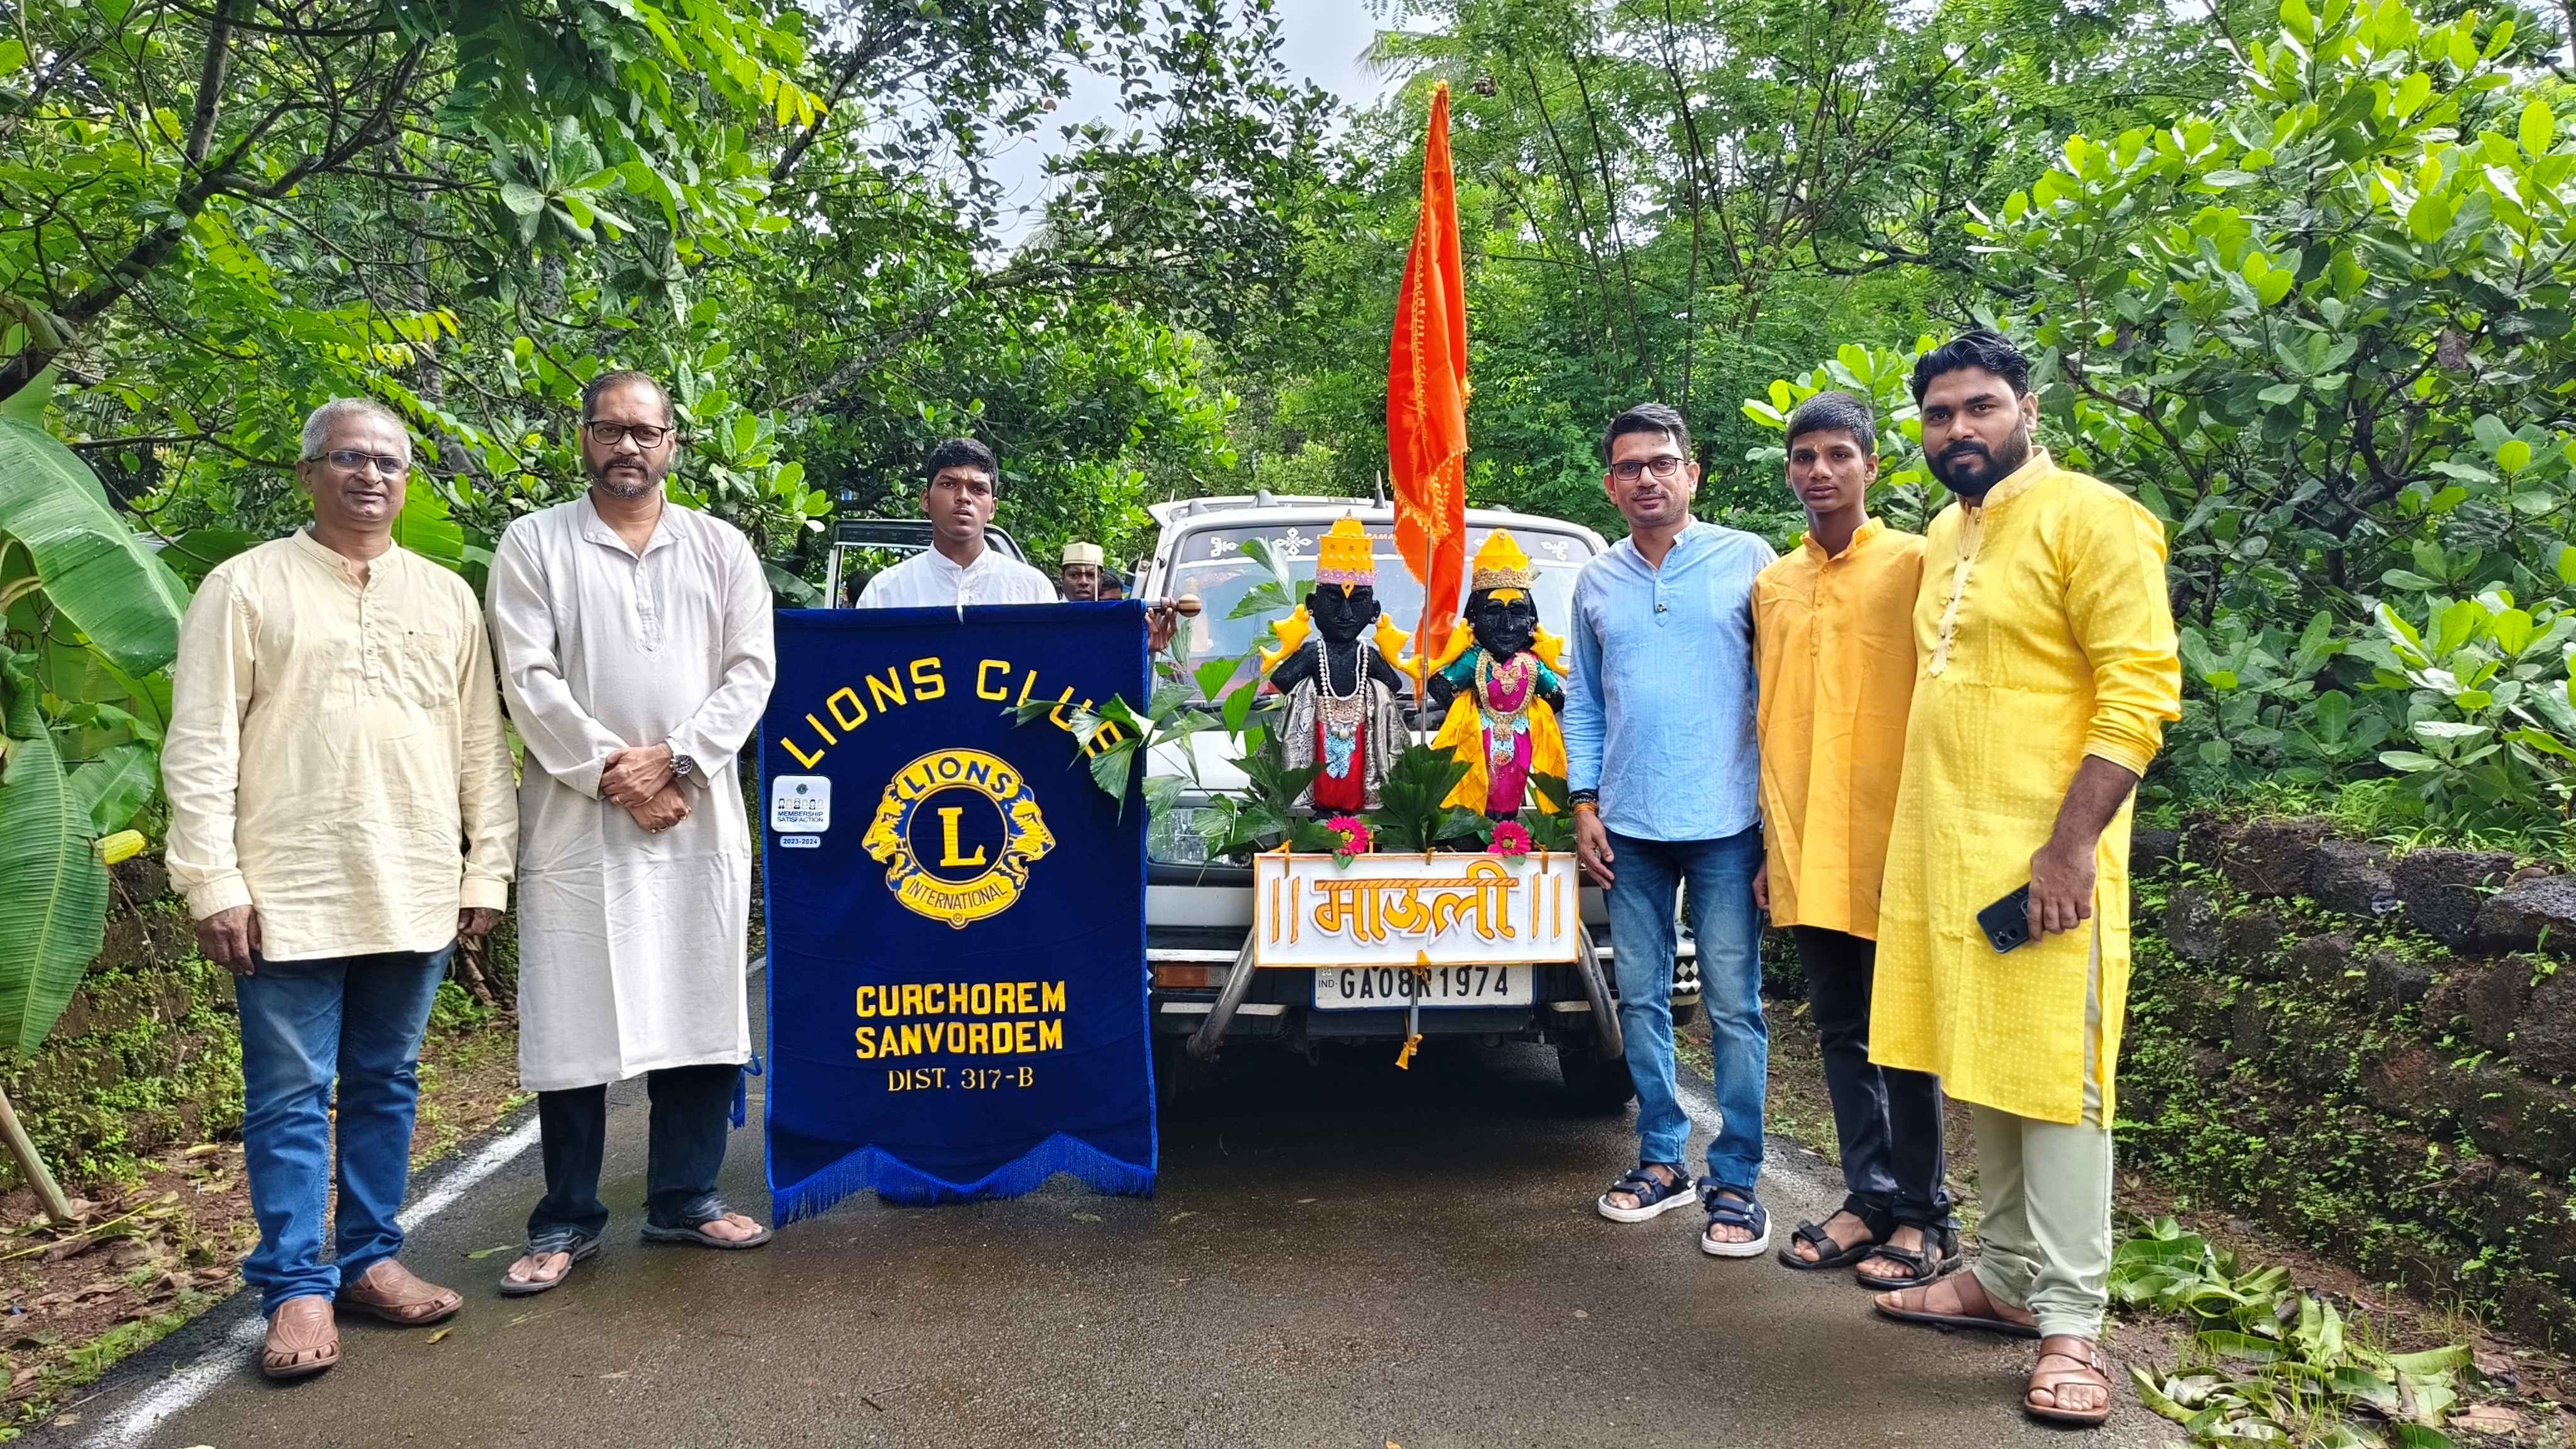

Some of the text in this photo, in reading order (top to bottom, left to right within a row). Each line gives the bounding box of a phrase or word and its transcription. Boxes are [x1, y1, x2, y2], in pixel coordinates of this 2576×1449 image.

[780, 657, 945, 769] LIONS
[903, 757, 1013, 794] LIONS
[938, 806, 987, 867] L
[906, 879, 1008, 910] INTERNATIONAL
[856, 980, 1066, 1018] CURCHOREM
[855, 1018, 1063, 1059] SANVORDEM
[888, 1067, 1034, 1091] DIST. 317-B
